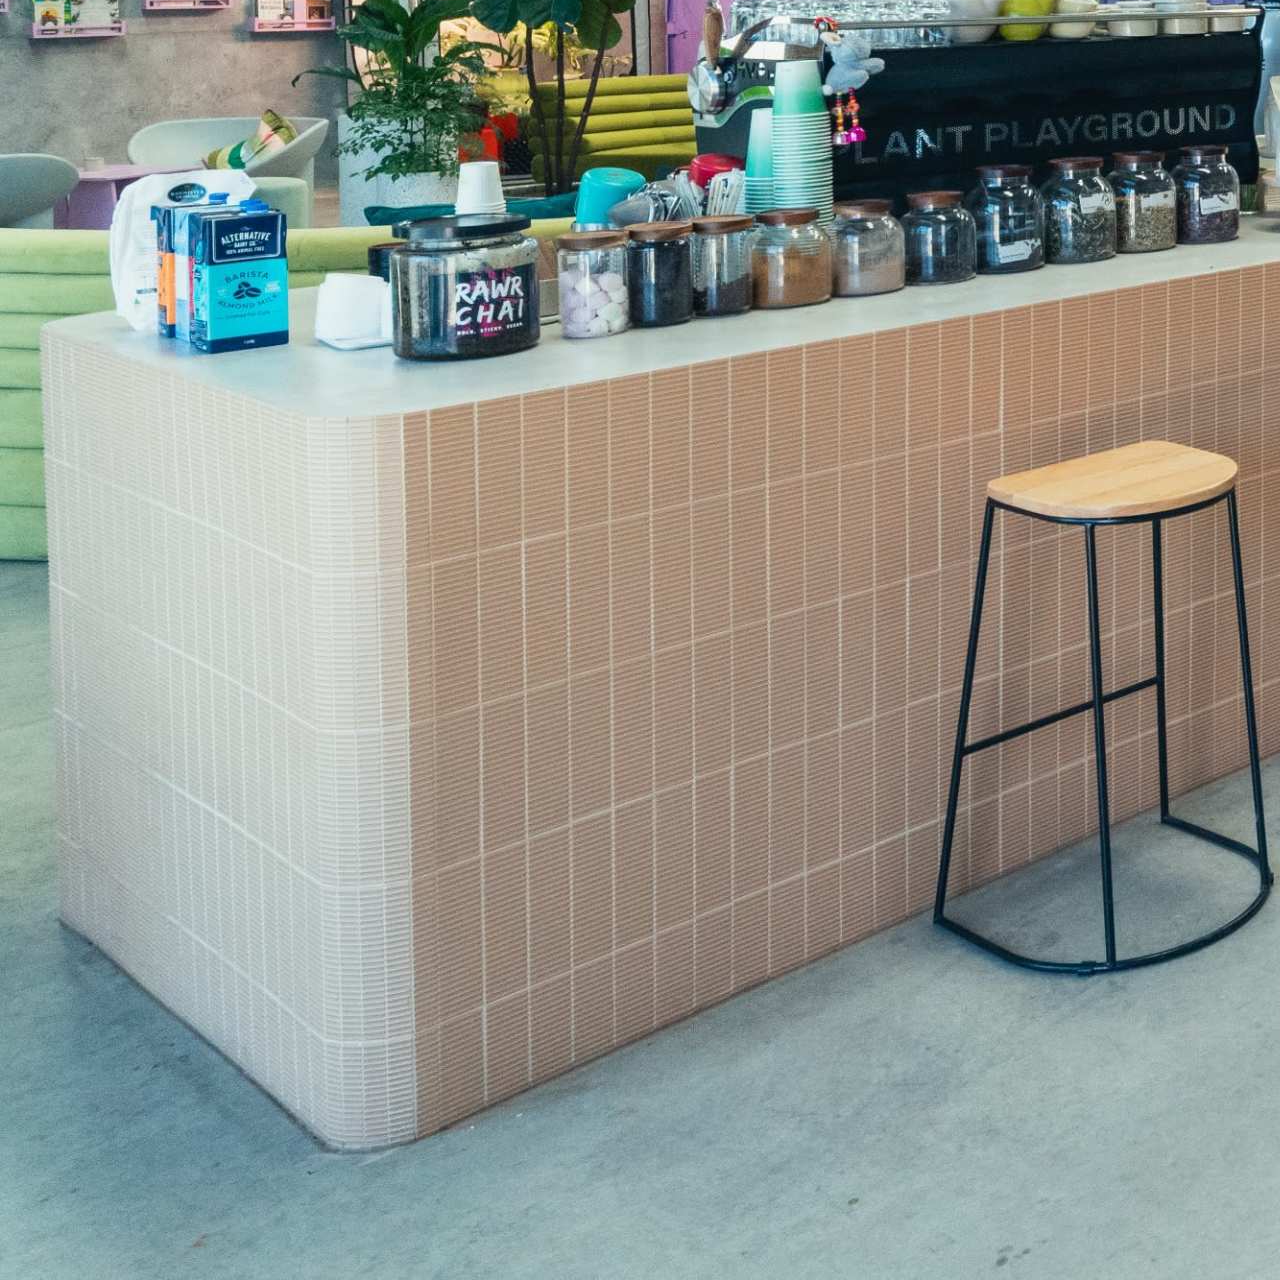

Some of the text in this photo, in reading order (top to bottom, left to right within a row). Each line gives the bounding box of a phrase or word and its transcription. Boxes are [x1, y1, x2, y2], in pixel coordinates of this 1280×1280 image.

[850, 104, 1237, 163] LANT PLAYGROUND
[221, 231, 271, 246] ALTERNATIVE
[224, 271, 269, 283] BARISTA
[456, 276, 524, 304] RAWR
[456, 298, 523, 326] CHAI
